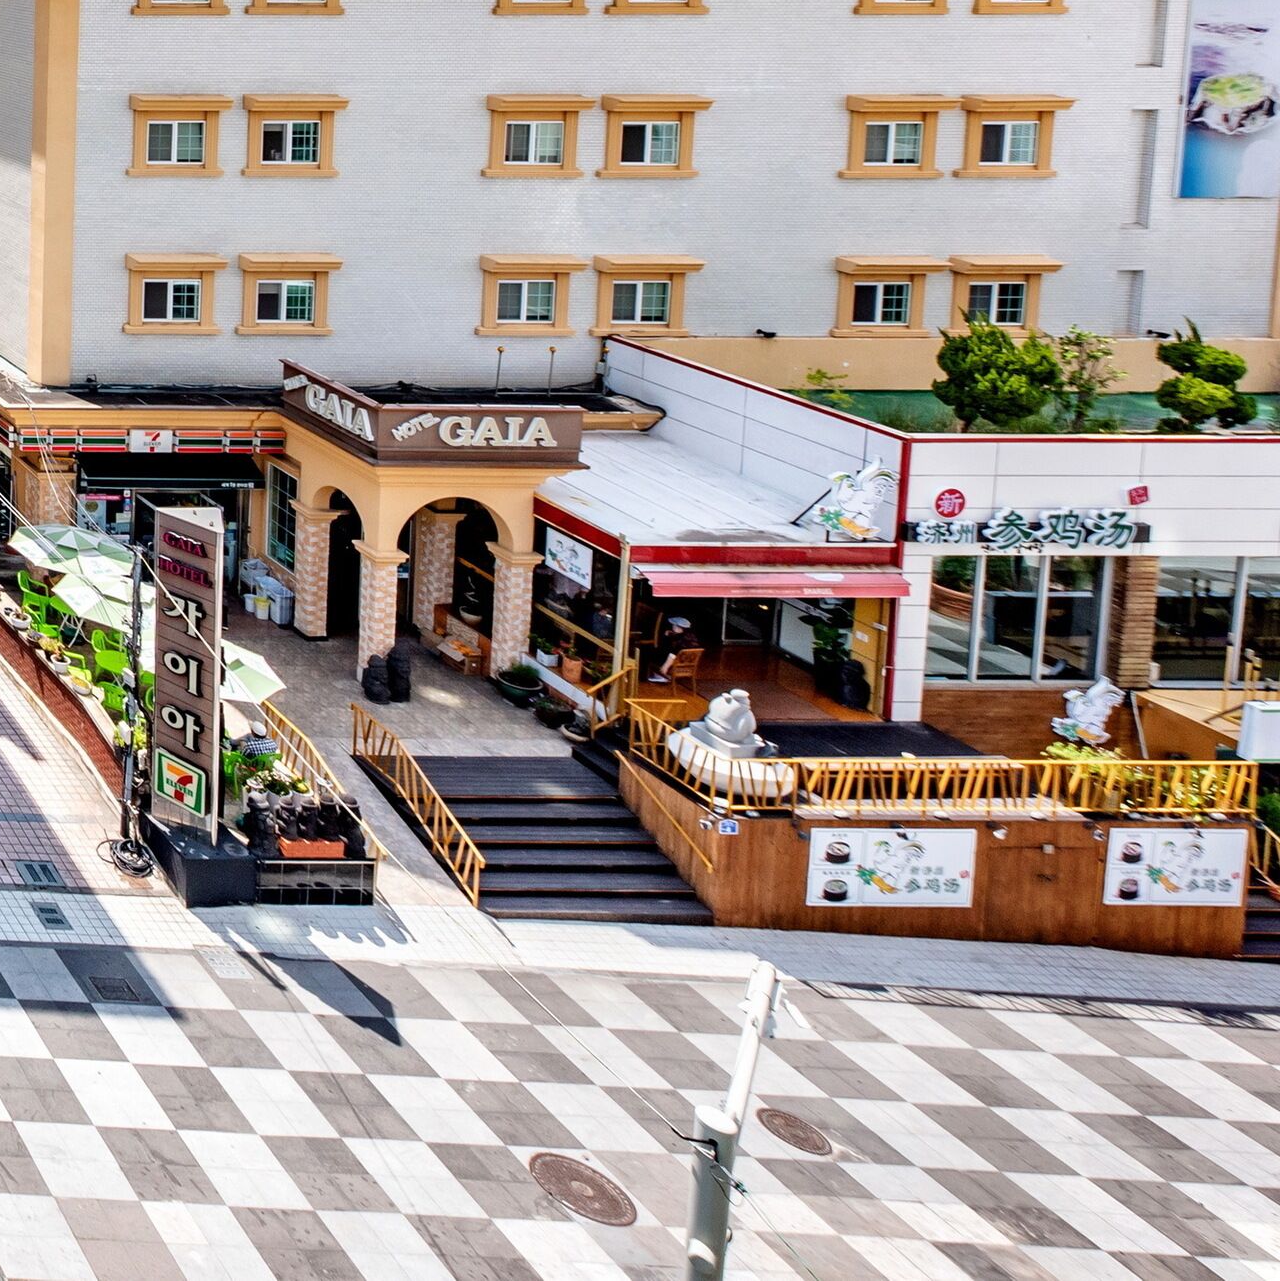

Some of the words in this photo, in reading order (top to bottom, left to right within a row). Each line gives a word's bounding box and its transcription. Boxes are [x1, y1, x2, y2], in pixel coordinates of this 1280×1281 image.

[304, 383, 375, 442] GAIA
[391, 412, 440, 442] HOTEL
[439, 416, 558, 447] GAIA
[938, 492, 963, 515] 新
[162, 529, 208, 559] GAIA
[158, 554, 212, 589] HOTEL
[162, 591, 206, 753] 가이아
[166, 762, 193, 804] 7
